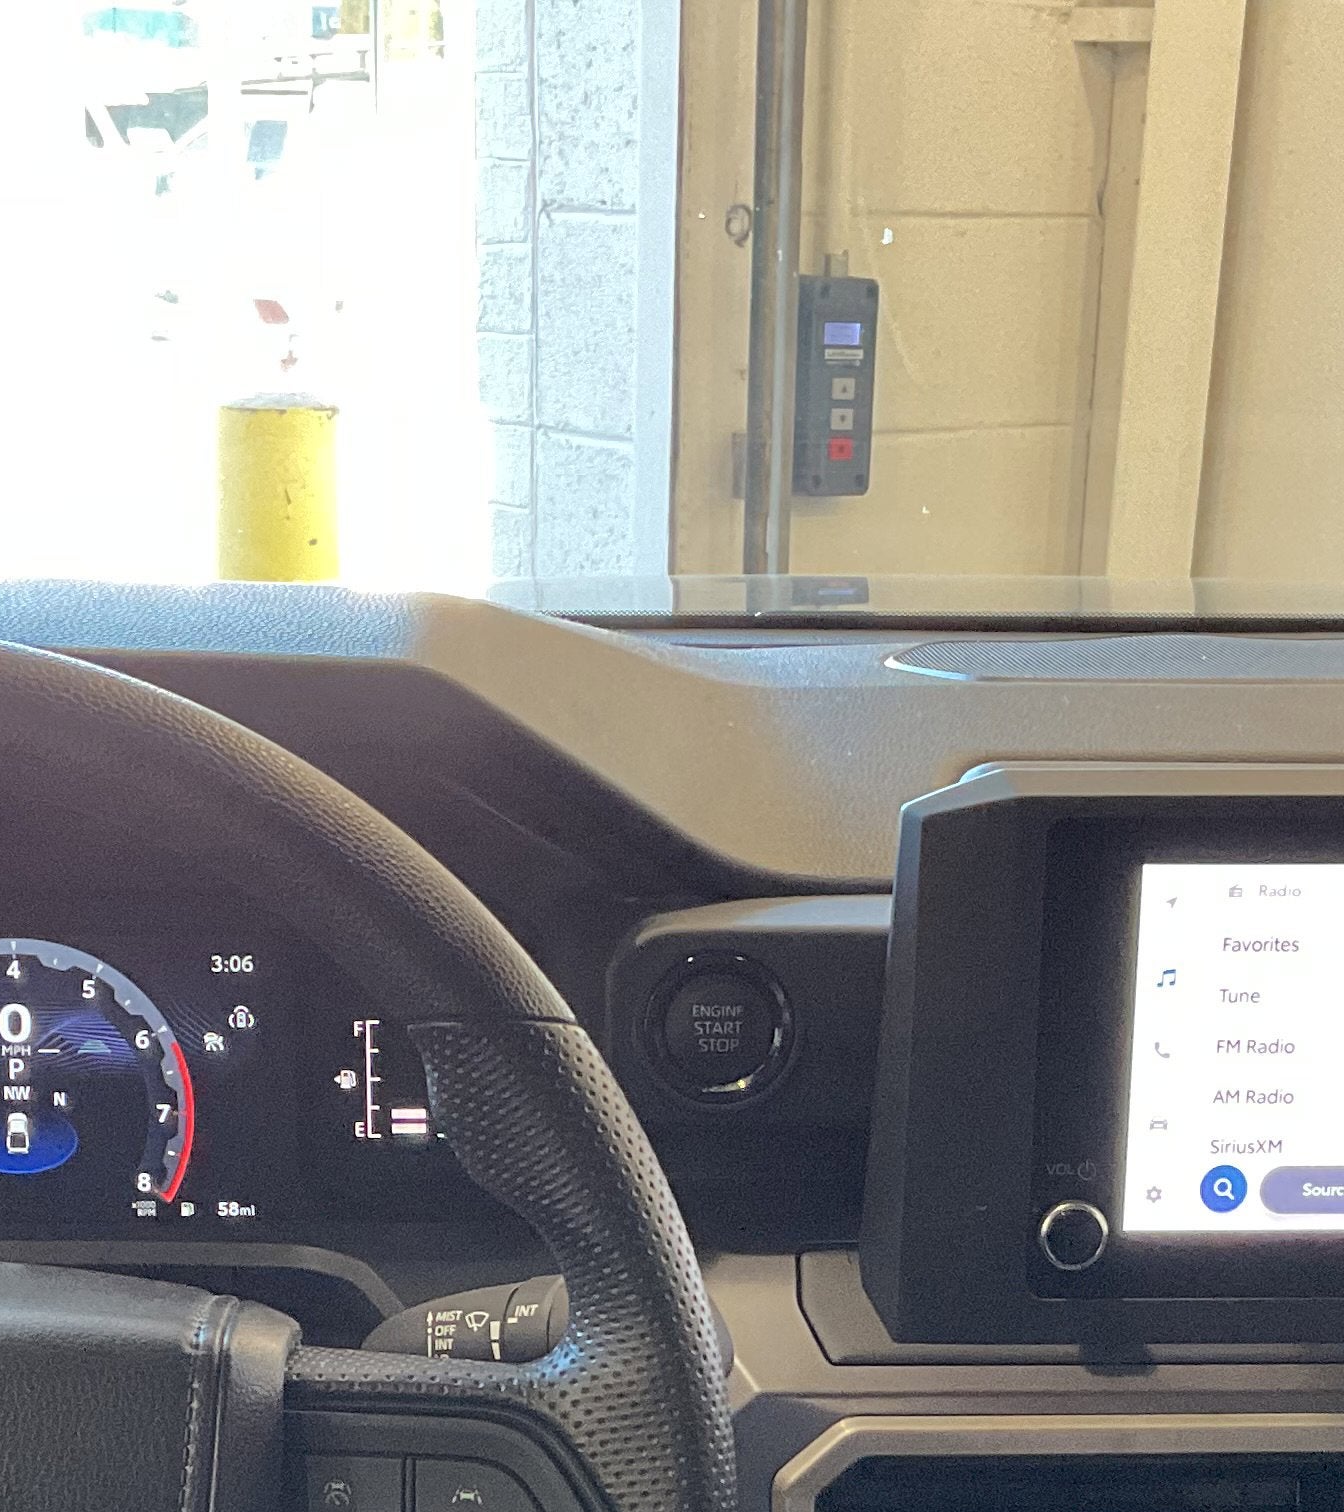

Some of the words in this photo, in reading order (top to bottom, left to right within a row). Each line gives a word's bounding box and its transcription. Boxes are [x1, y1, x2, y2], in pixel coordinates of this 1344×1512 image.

[1259, 885, 1302, 898] Radio
[1222, 937, 1300, 953] Favorites
[6, 961, 21, 979] 4
[210, 955, 254, 973] 3:06
[82, 980, 96, 999] 5
[1220, 989, 1260, 1004] Tune
[692, 1004, 744, 1017] ENGINE
[353, 1021, 364, 1037] F
[695, 1022, 743, 1035] START
[135, 1030, 150, 1049] 6
[699, 1039, 739, 1052] STOP
[1216, 1040, 1241, 1055] FM
[1246, 1039, 1296, 1055] Radio
[1, 1044, 31, 1057] MPH
[9, 1059, 25, 1080] P
[4, 1086, 31, 1101] NW
[54, 1093, 67, 1107] N
[1213, 1090, 1240, 1105] AM
[1246, 1089, 1295, 1105] Radio
[157, 1104, 171, 1123] 7
[355, 1122, 366, 1138] E
[1210, 1140, 1284, 1155] SiriusXM
[1045, 1163, 1076, 1175] VOL
[136, 1173, 152, 1192] 8
[436, 1310, 463, 1322] MIST
[515, 1304, 538, 1317] INT
[435, 1324, 457, 1337] OFF
[435, 1338, 454, 1350] INT
